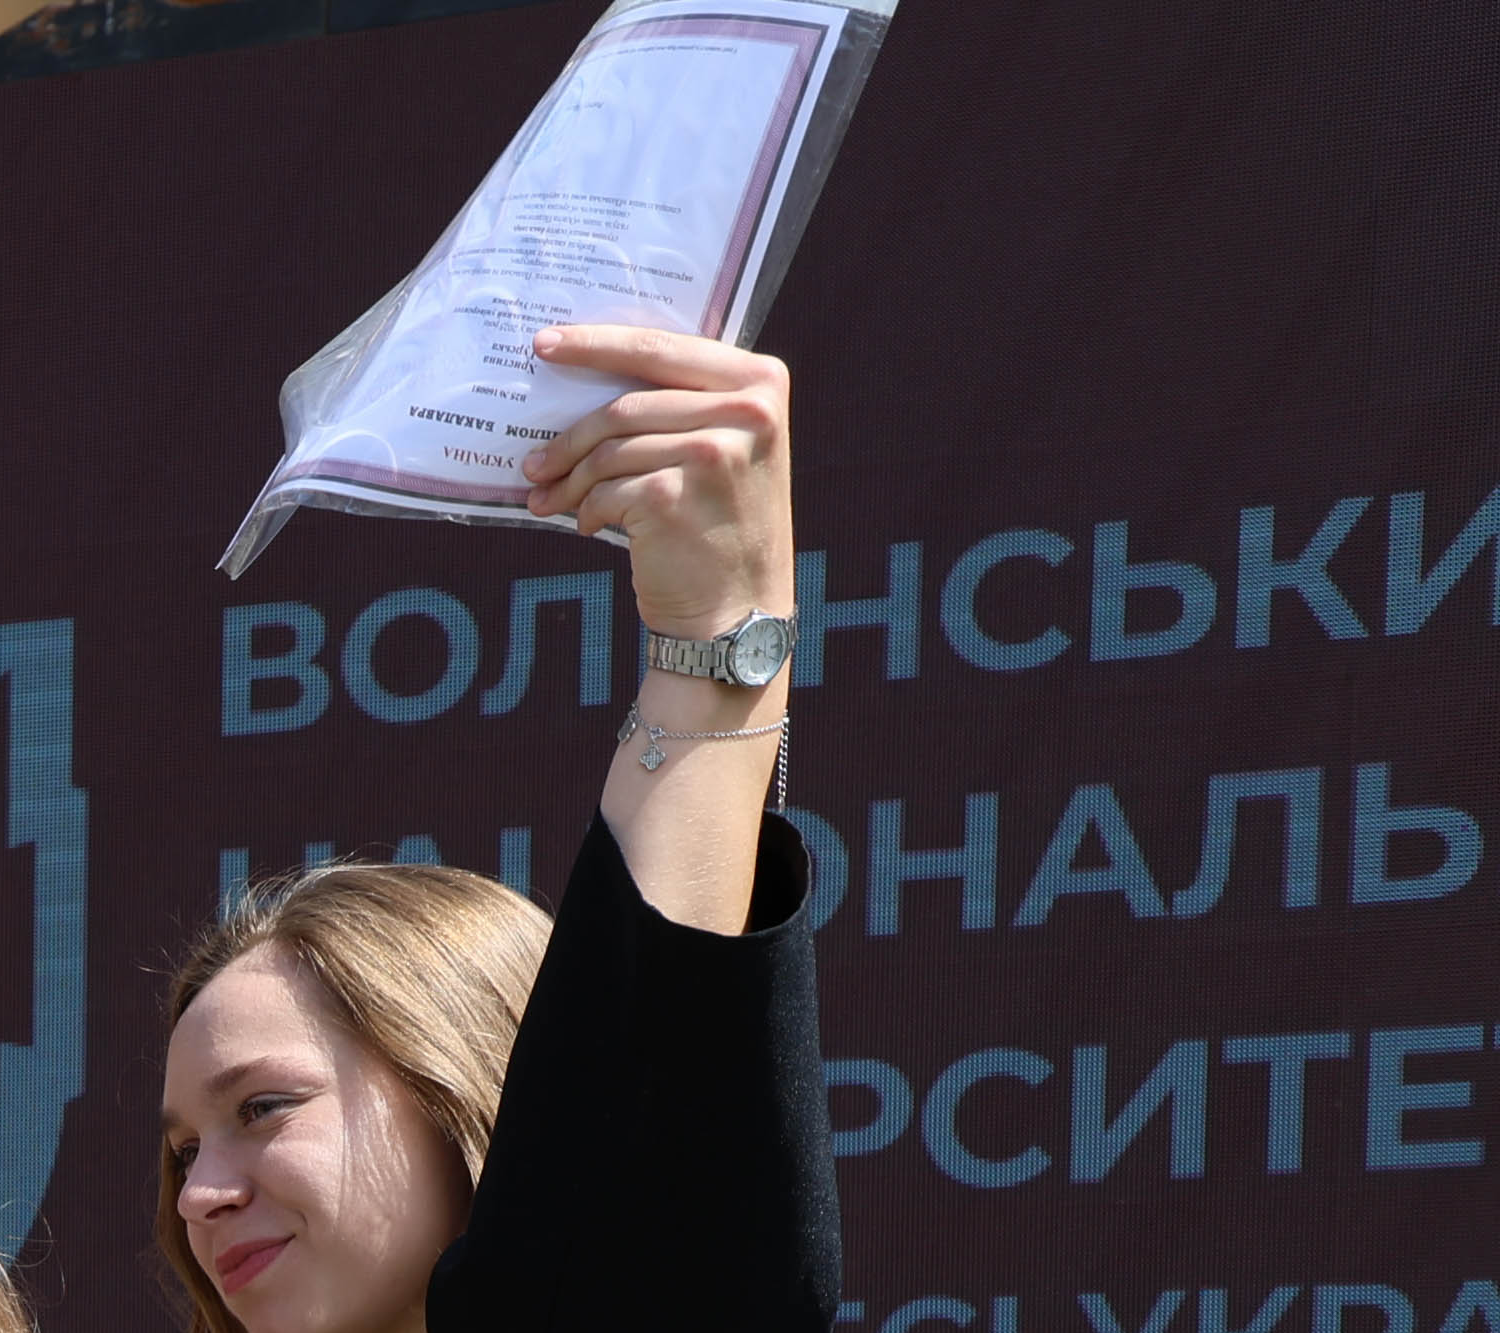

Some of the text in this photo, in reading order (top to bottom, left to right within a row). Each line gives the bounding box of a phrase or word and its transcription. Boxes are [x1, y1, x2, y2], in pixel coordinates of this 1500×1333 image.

[483, 356, 537, 375] Христина
[410, 407, 561, 441] ПЛОМ БАКАЛАВРА
[444, 447, 514, 468] УКРАЇНА
[219, 488, 1500, 737] ВОЛНСЬКИ
